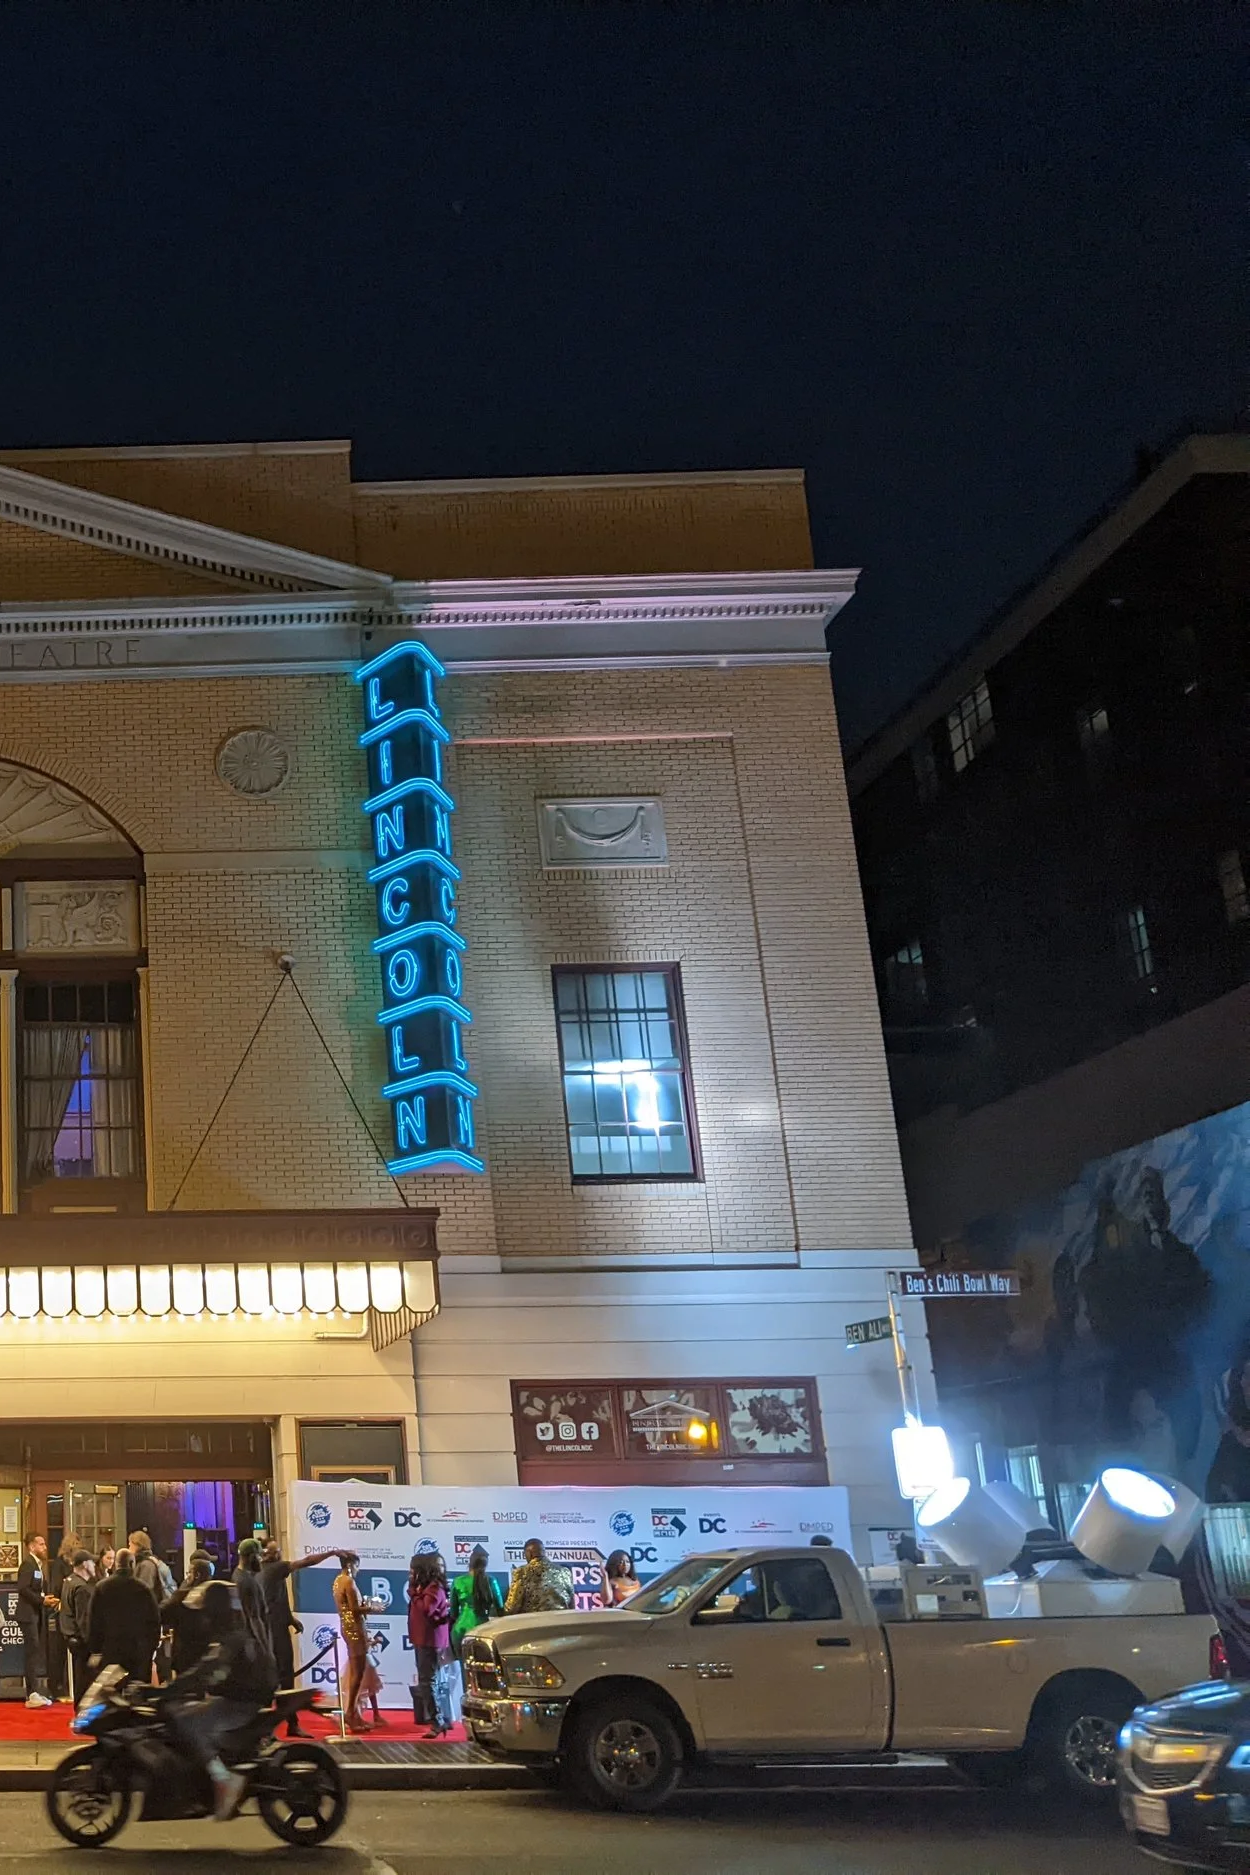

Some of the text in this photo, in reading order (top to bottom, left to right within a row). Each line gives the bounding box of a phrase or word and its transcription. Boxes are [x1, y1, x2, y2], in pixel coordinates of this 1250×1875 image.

[368, 676, 426, 1150] LINCOLN
[906, 1272, 1011, 1293] Ben's Chili Bowl Way
[846, 1323, 865, 1343] BEN
[868, 1320, 882, 1339] ALI
[348, 1508, 364, 1519] DC
[394, 1511, 422, 1528] DC
[493, 1512, 528, 1521] DMPED
[652, 1515, 669, 1526] DC
[698, 1517, 727, 1533] DC
[455, 1543, 471, 1553] DC
[507, 1551, 527, 1560] THE
[552, 1552, 596, 1561] ANNUAL
[630, 1546, 658, 1563] DC
[574, 1592, 604, 1609] RTS
[1, 1627, 24, 1637] GUE
[1, 1637, 25, 1645] CHEC
[311, 1667, 338, 1684] DC
